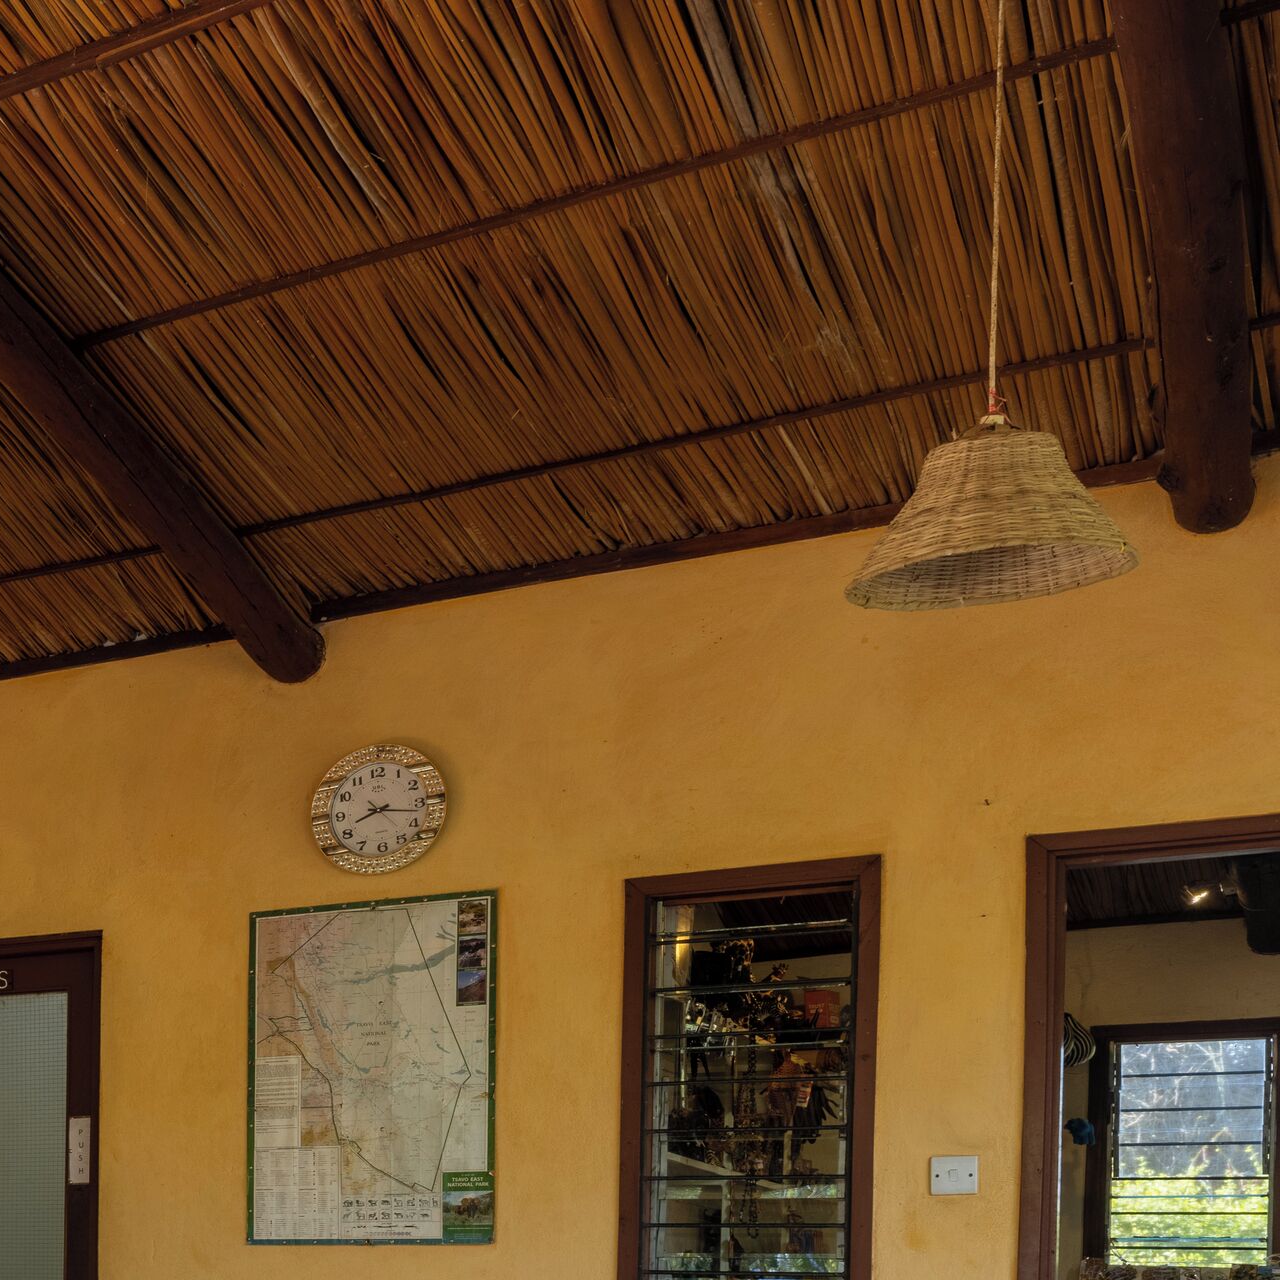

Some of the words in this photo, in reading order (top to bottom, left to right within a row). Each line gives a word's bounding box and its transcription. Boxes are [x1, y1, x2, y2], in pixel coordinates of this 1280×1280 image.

[370, 766, 386, 780] 12
[396, 768, 401, 778] 1
[352, 776, 363, 787] 11
[408, 779, 419, 791] 2
[340, 791, 351, 802] 10
[414, 797, 426, 808] 3
[335, 812, 345, 823] 9
[408, 817, 419, 828] 4
[342, 828, 353, 840] 8
[396, 833, 407, 845] 5
[356, 840, 367, 851] 7
[377, 842, 388, 853] 6
[77, 1128, 85, 1175] PUSH
